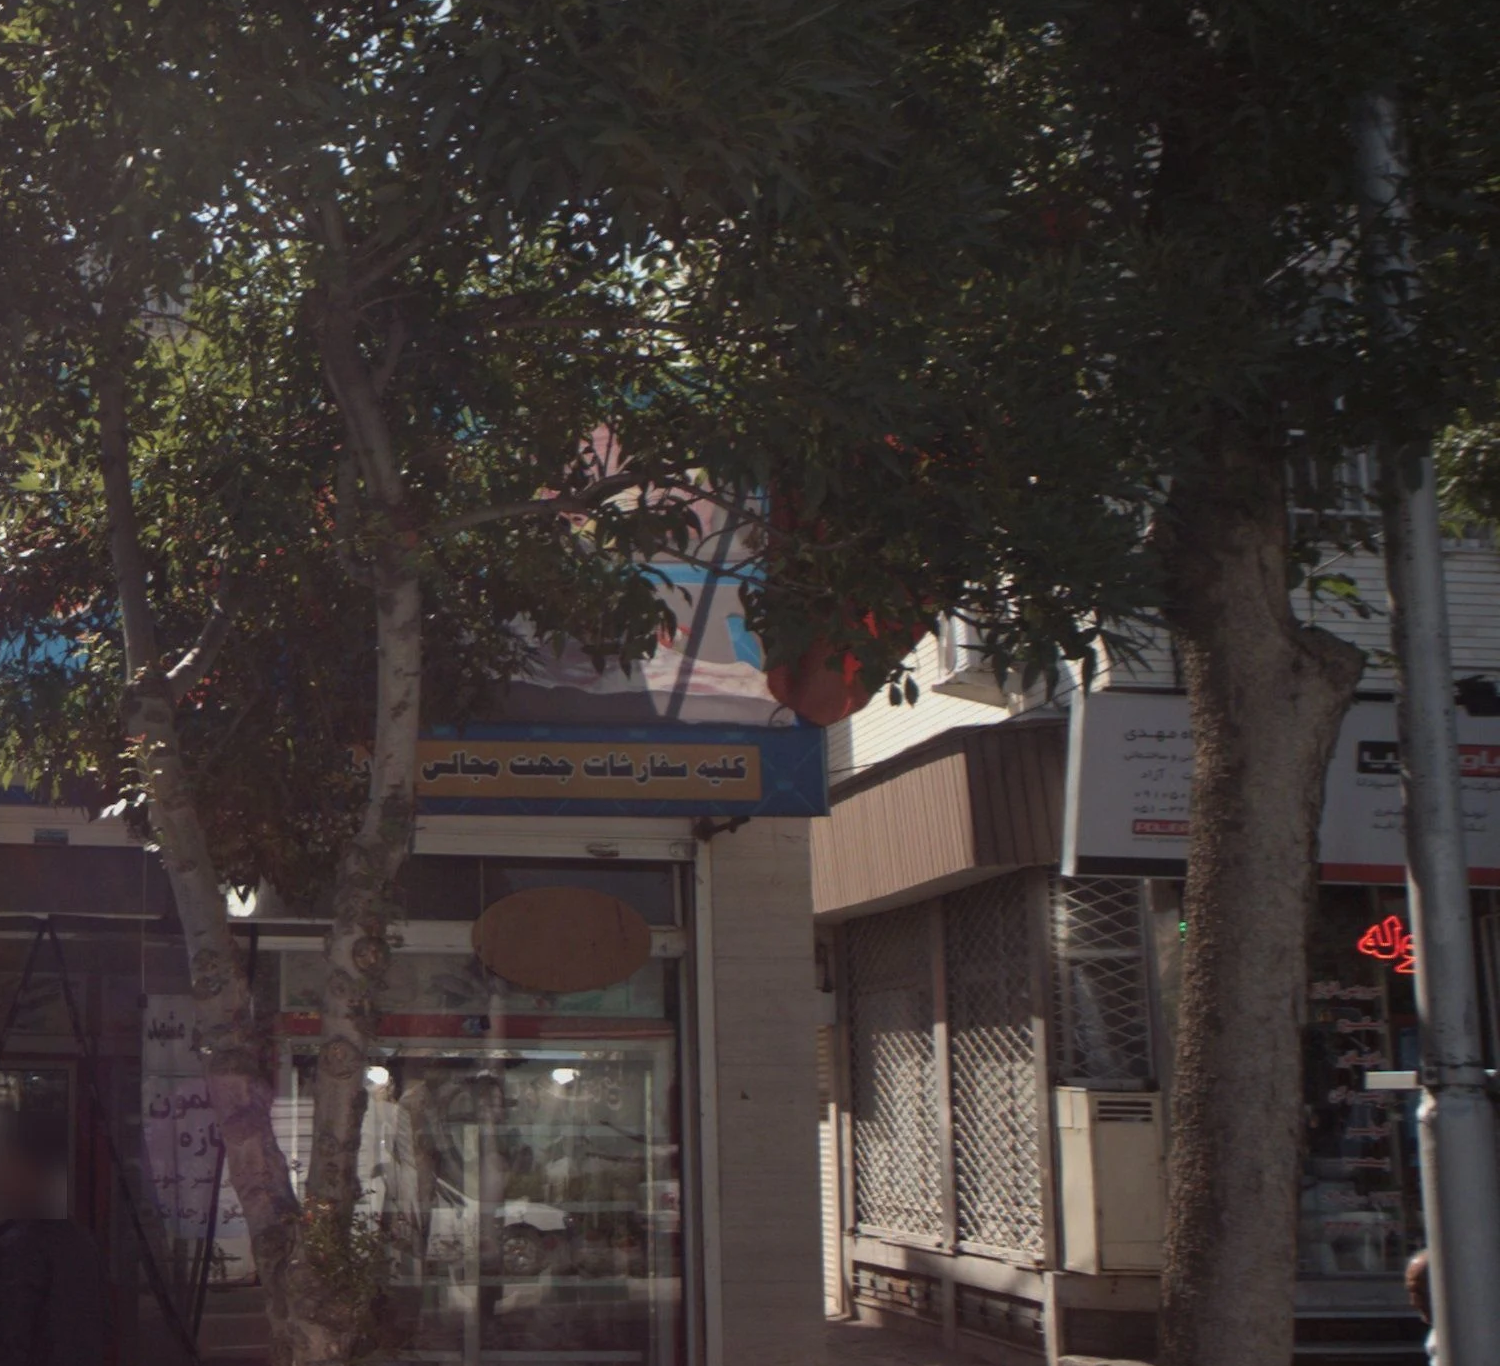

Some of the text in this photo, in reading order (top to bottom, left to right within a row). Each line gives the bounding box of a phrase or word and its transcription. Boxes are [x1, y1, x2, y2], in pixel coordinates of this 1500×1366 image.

[509, 753, 575, 783] جهت
[583, 753, 689, 784] سفارشات
[696, 754, 748, 786] کلیه
